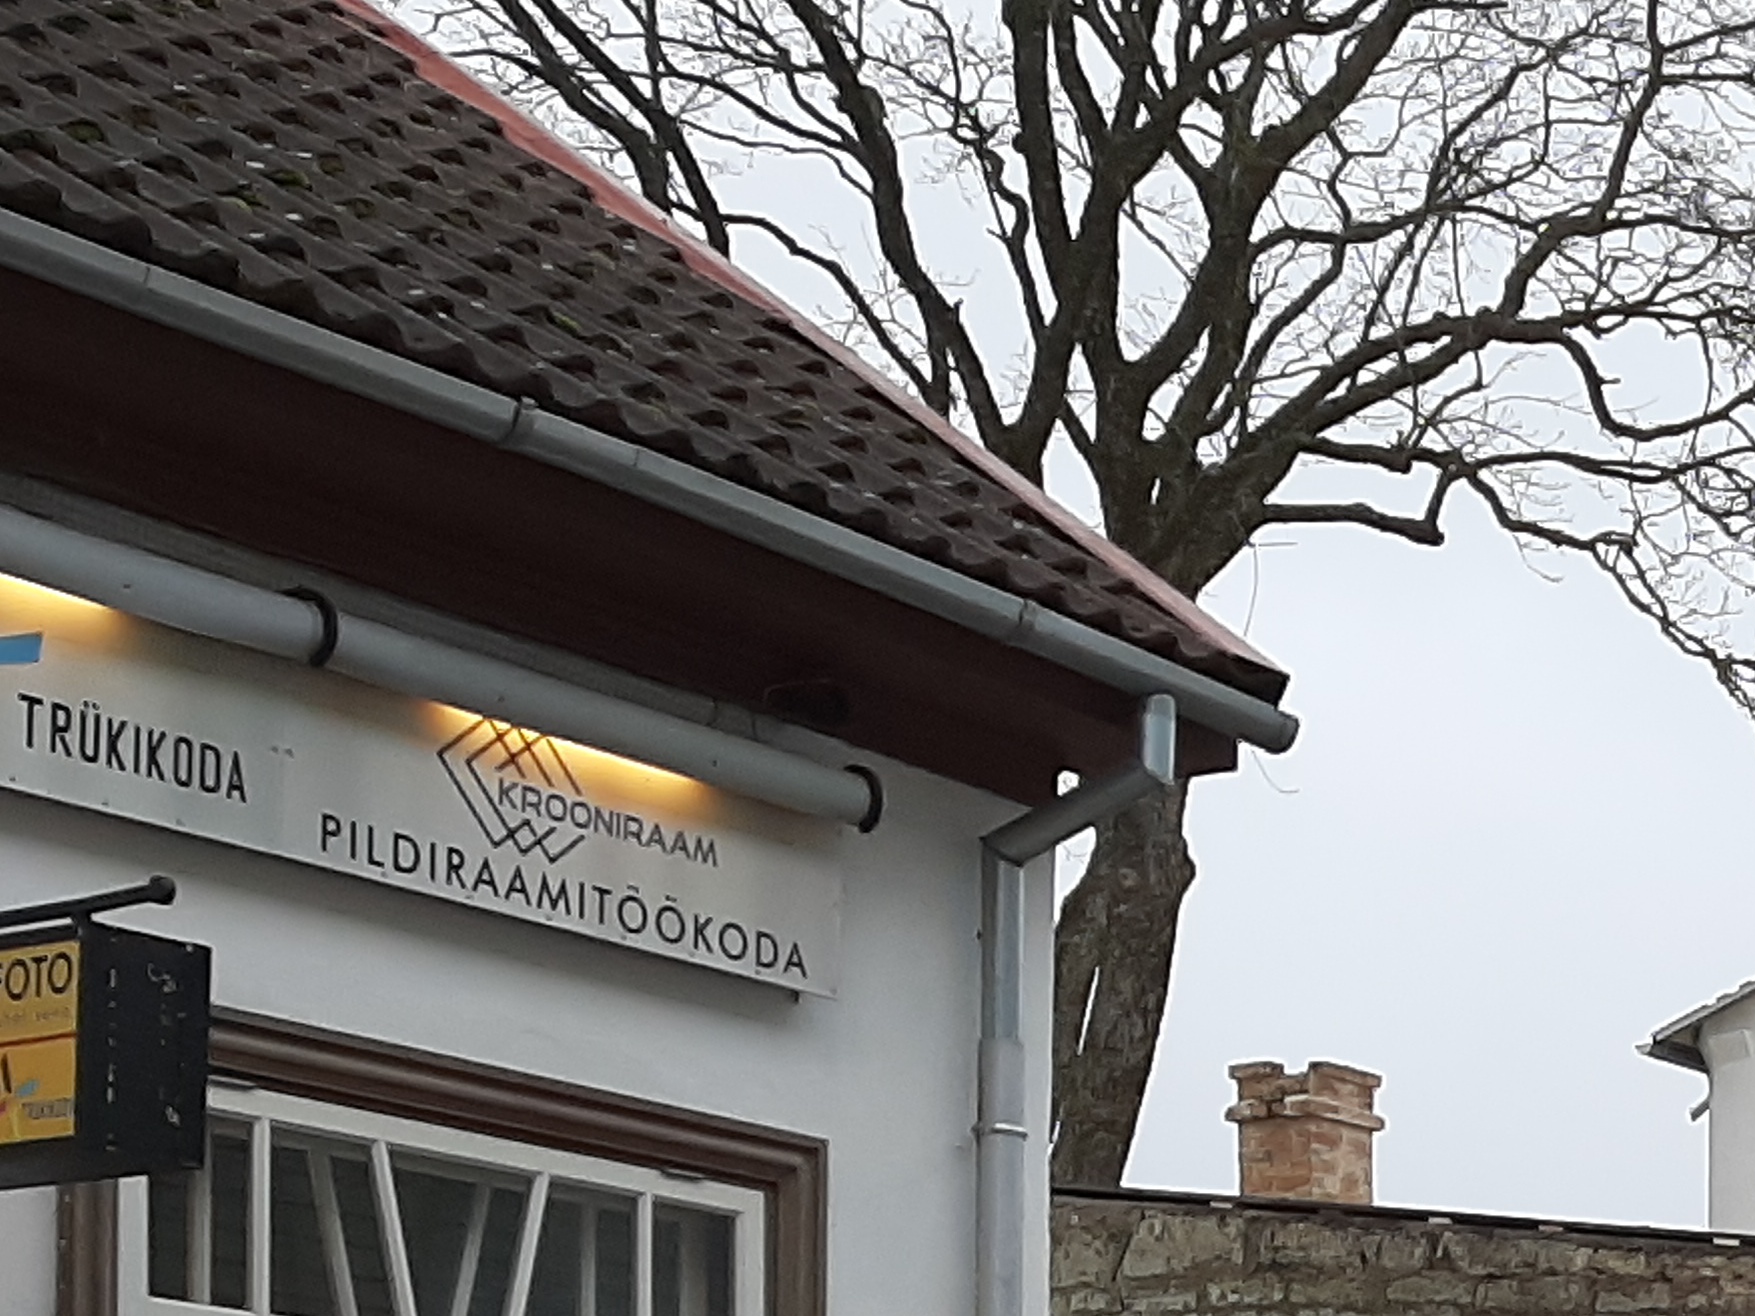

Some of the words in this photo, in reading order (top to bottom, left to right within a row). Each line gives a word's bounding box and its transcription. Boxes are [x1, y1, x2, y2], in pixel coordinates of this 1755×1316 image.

[18, 692, 247, 803] TRÜKIKODA
[500, 777, 719, 867] KROONIRAAM
[0, 952, 73, 1002] OTO
